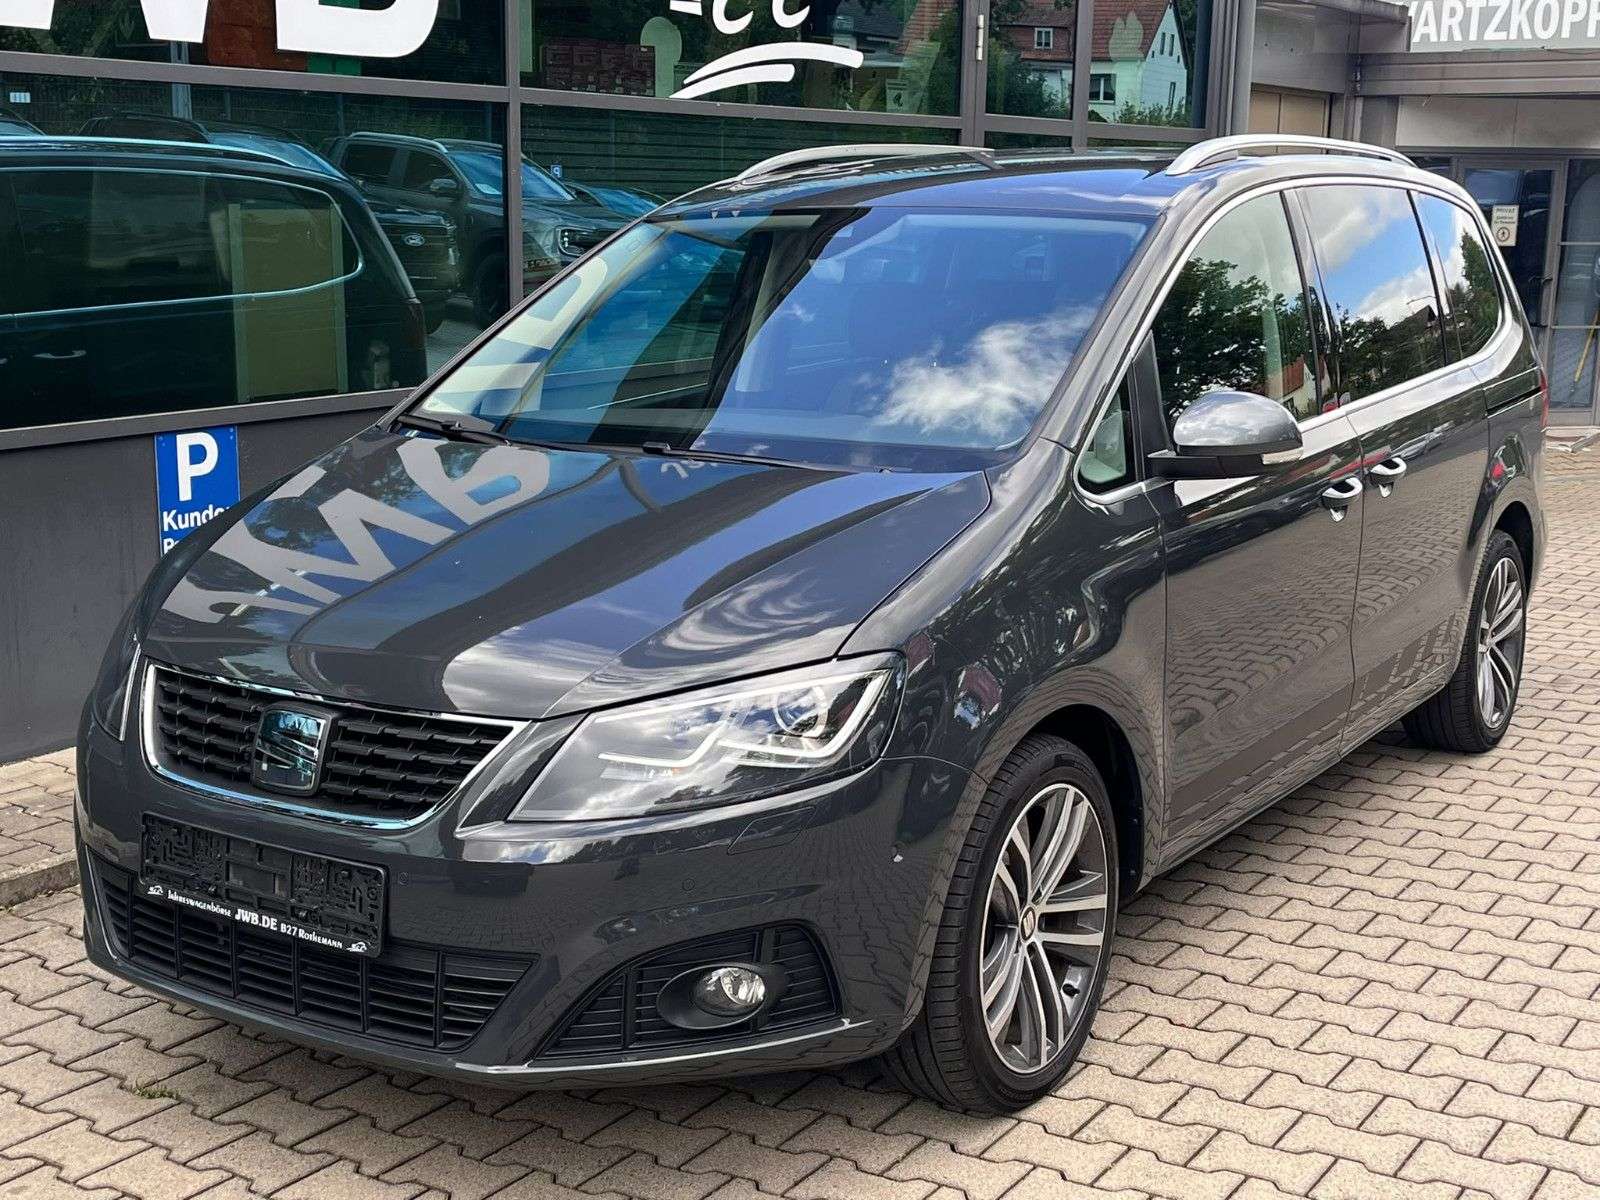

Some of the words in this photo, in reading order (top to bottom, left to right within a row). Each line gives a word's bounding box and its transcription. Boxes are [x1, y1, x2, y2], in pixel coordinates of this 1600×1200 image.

[176, 431, 219, 502] P
[235, 908, 278, 931] JWB.DE
[280, 923, 298, 936] B27
